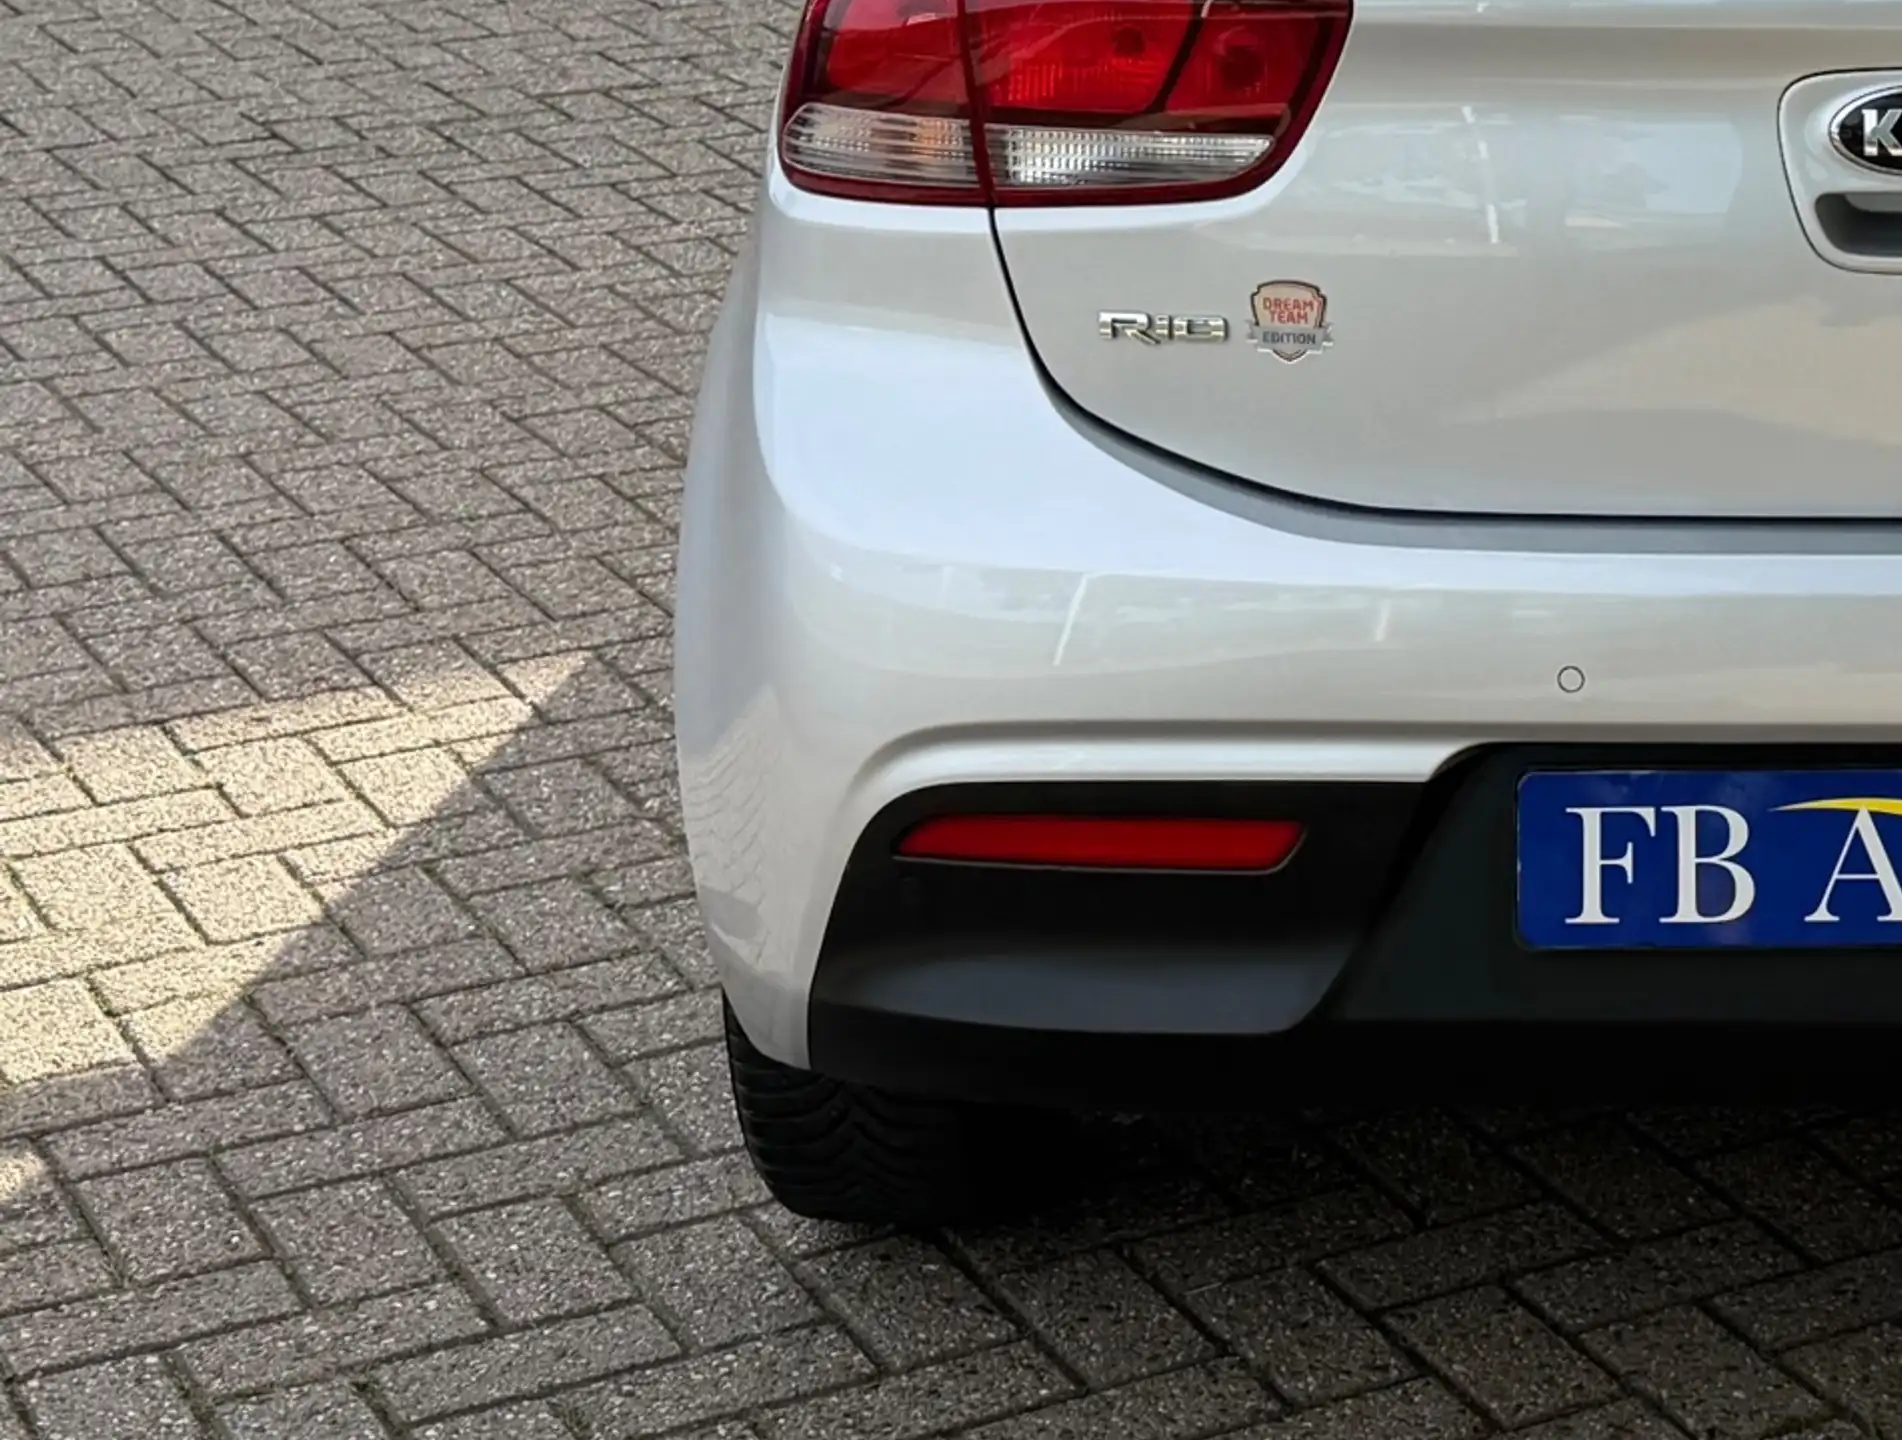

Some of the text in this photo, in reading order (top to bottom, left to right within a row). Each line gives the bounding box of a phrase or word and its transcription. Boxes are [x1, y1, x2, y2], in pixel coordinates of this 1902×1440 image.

[1262, 296, 1315, 311] DREAM
[1269, 310, 1310, 324] TEAM
[1261, 330, 1317, 345] EDITION
[1564, 804, 1756, 924] FB
